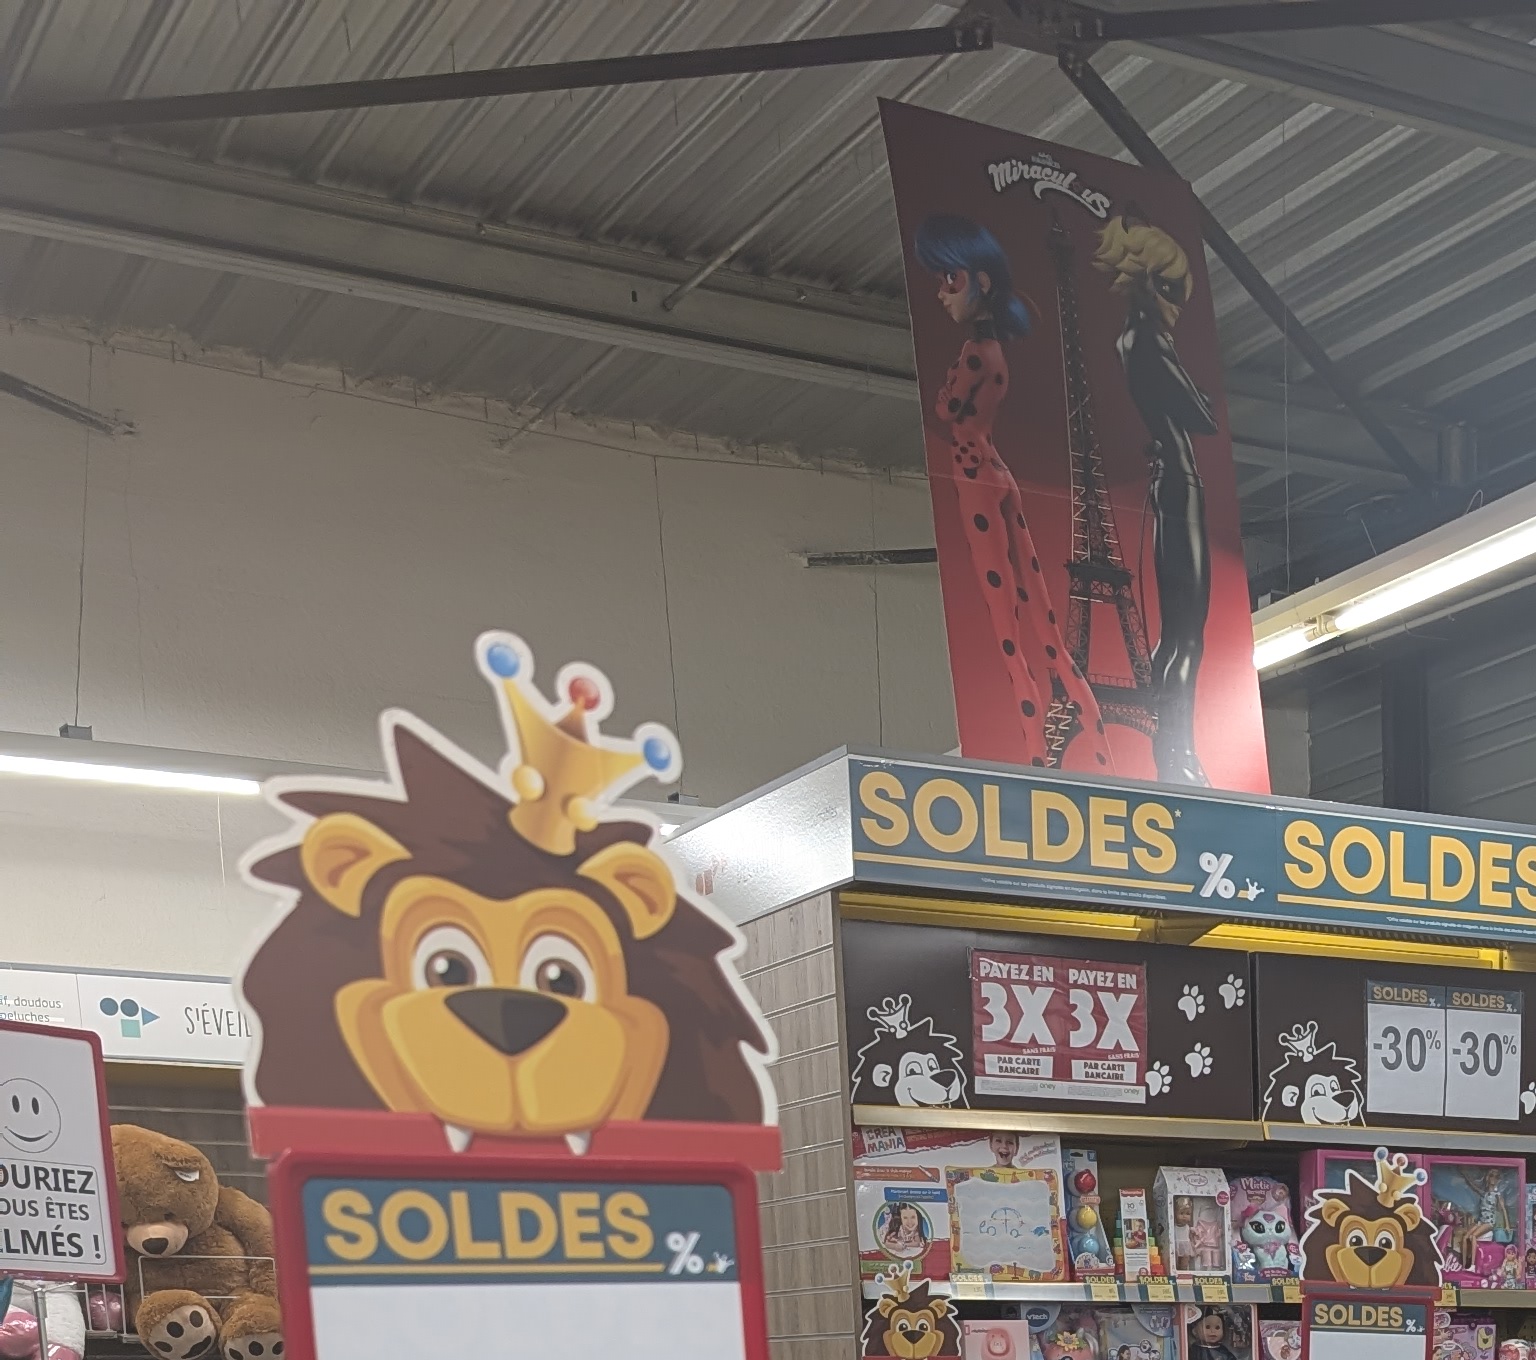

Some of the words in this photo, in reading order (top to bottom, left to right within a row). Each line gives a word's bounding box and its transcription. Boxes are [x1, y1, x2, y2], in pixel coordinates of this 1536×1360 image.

[980, 962, 1029, 979] PAYEZ
[1034, 966, 1054, 982] EN
[1069, 969, 1114, 987] PAYEZ
[1118, 974, 1137, 989] EN
[15, 997, 61, 1009] doudous
[1373, 986, 1427, 1002] SOLDES
[1452, 992, 1504, 1008] SOLDES
[981, 982, 1056, 1045] 3X
[1070, 989, 1139, 1051] 3X
[1373, 1025, 1441, 1072] -30%
[1453, 1031, 1516, 1076] -30%
[998, 1056, 1013, 1065] PAR
[1015, 1058, 1040, 1066] CARTE
[999, 1066, 1039, 1075] BANCAIRE
[46, 1197, 90, 1221] ÊTES
[323, 1189, 655, 1261] SOLDES
[1314, 1304, 1403, 1328] SOLDES
